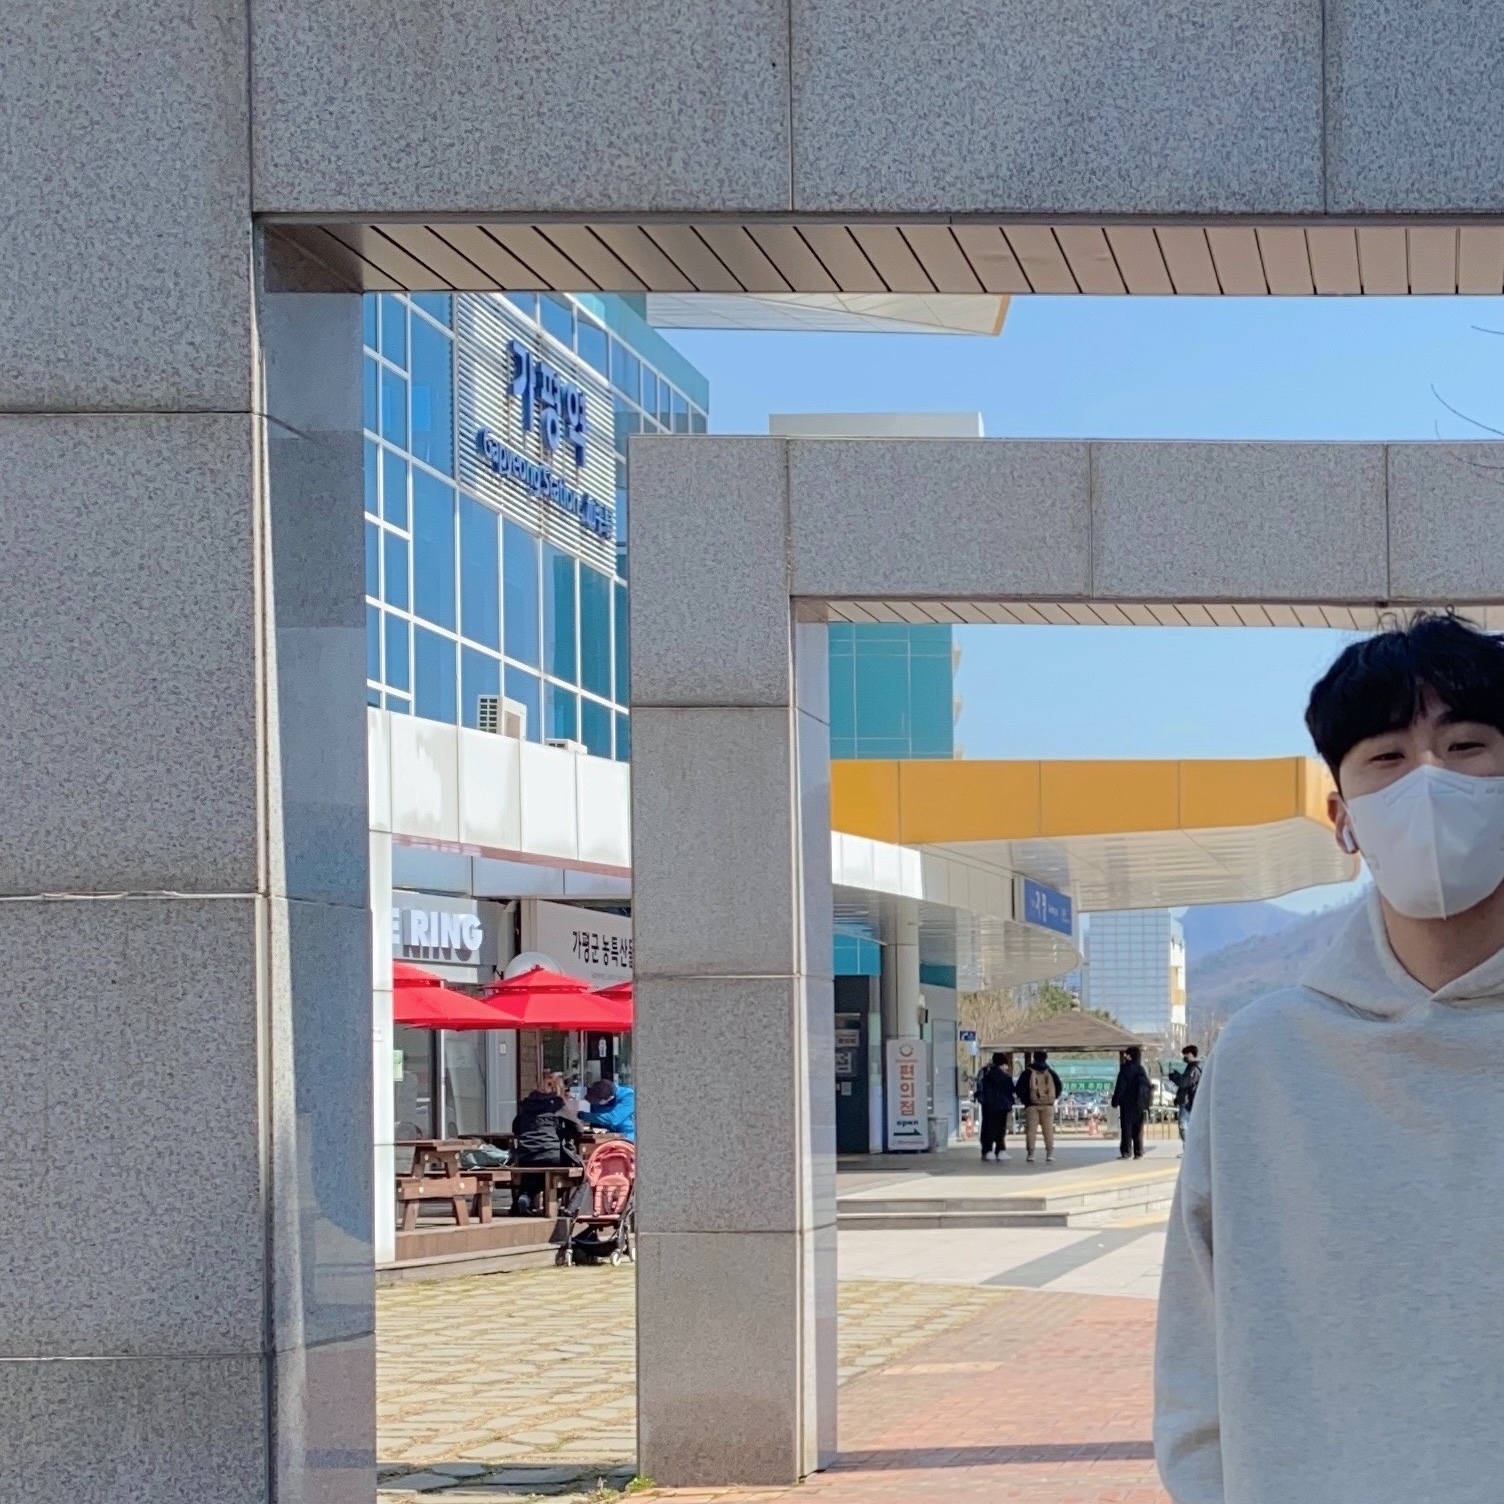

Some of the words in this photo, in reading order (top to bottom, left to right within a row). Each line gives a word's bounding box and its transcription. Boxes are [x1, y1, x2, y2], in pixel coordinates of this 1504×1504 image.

[506, 340, 587, 468] 가평역
[478, 430, 544, 497] Gapyeong
[541, 465, 582, 517] Station
[404, 909, 483, 951] RING
[572, 931, 600, 964] 가평군
[896, 1119, 919, 1127] open
